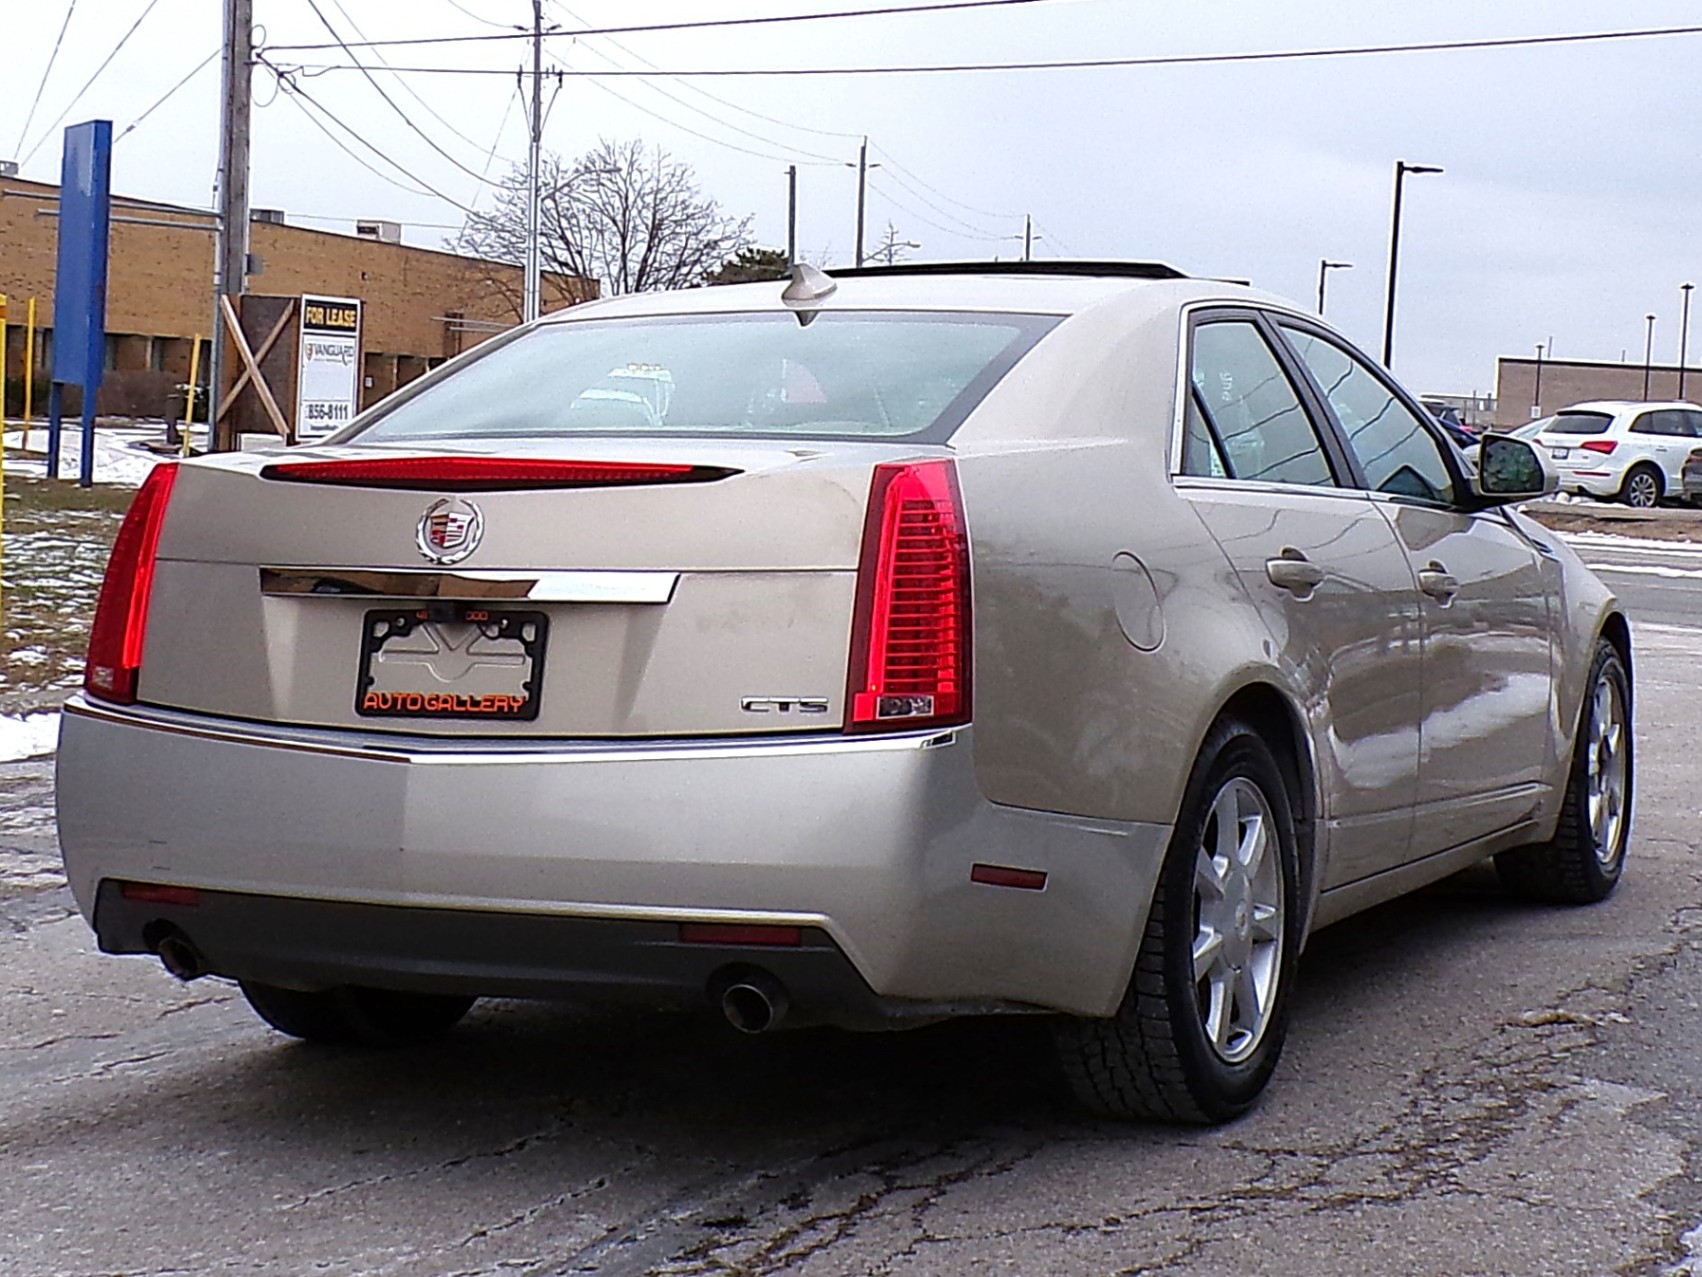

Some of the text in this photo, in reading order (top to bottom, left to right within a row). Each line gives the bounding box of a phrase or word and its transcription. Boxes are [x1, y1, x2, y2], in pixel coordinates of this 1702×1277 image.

[305, 306, 356, 327] FOR LEASE
[363, 692, 524, 713] AUTO GALLERY
[740, 697, 828, 713] CTS
